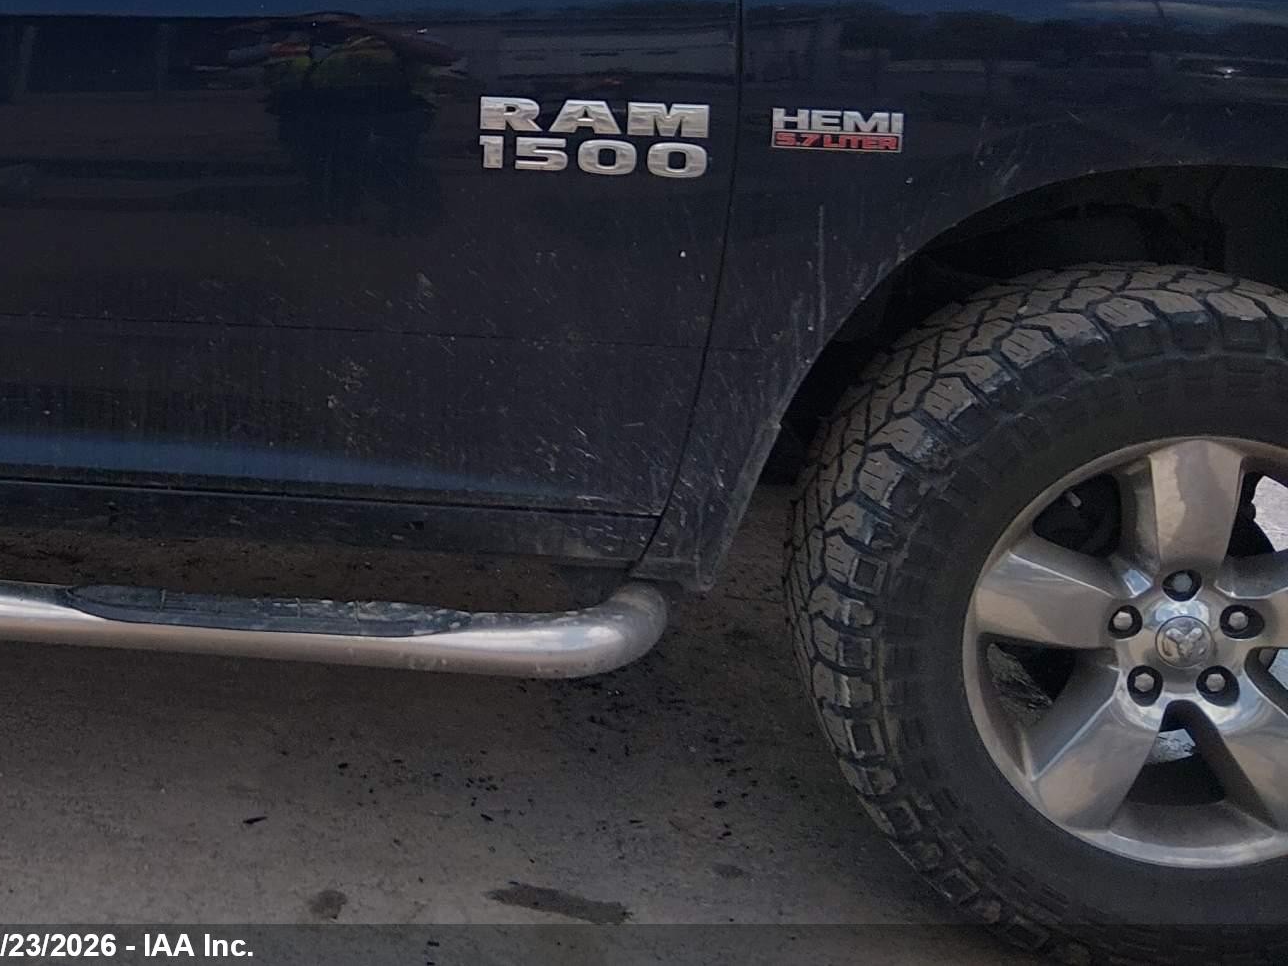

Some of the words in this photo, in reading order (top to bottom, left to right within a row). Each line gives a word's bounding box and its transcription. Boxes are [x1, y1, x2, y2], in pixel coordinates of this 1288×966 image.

[480, 96, 709, 138] RAM
[772, 107, 904, 134] HEMI
[479, 135, 708, 178] 1500
[775, 132, 821, 146] 5.7
[823, 134, 898, 150] LITER
